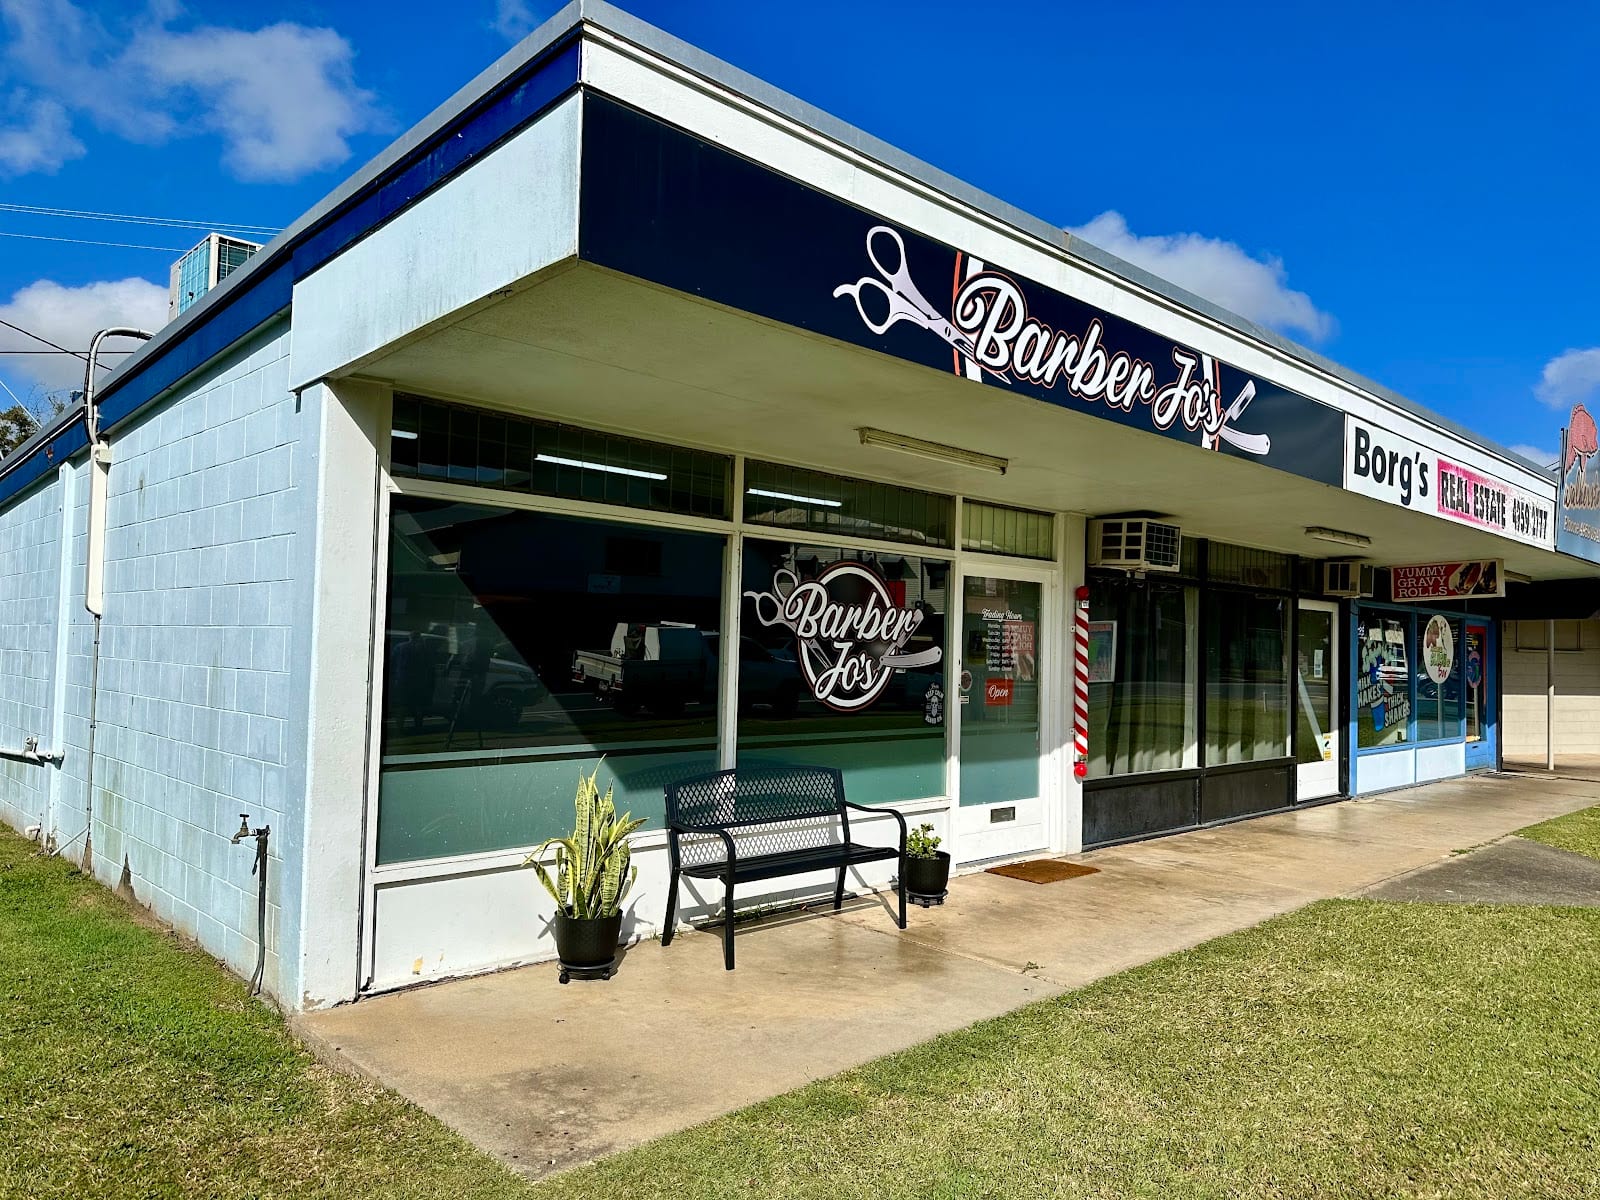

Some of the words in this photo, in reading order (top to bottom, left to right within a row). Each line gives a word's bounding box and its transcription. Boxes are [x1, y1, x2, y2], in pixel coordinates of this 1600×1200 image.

[955, 275, 1155, 408] Barber
[1153, 350, 1225, 434] Jo's
[1353, 426, 1429, 506] Borg's
[1441, 471, 1470, 515] REAL
[1473, 483, 1506, 528] ESTATE
[1397, 566, 1447, 578] YUMMY
[1397, 577, 1447, 588] GRAVY
[1399, 587, 1448, 598] ROLLS
[784, 582, 915, 641] Barber
[815, 641, 878, 700] Jo's
[988, 684, 1009, 700] Open
[1387, 692, 1404, 709] THICK
[1384, 701, 1411, 727] SHAKES
